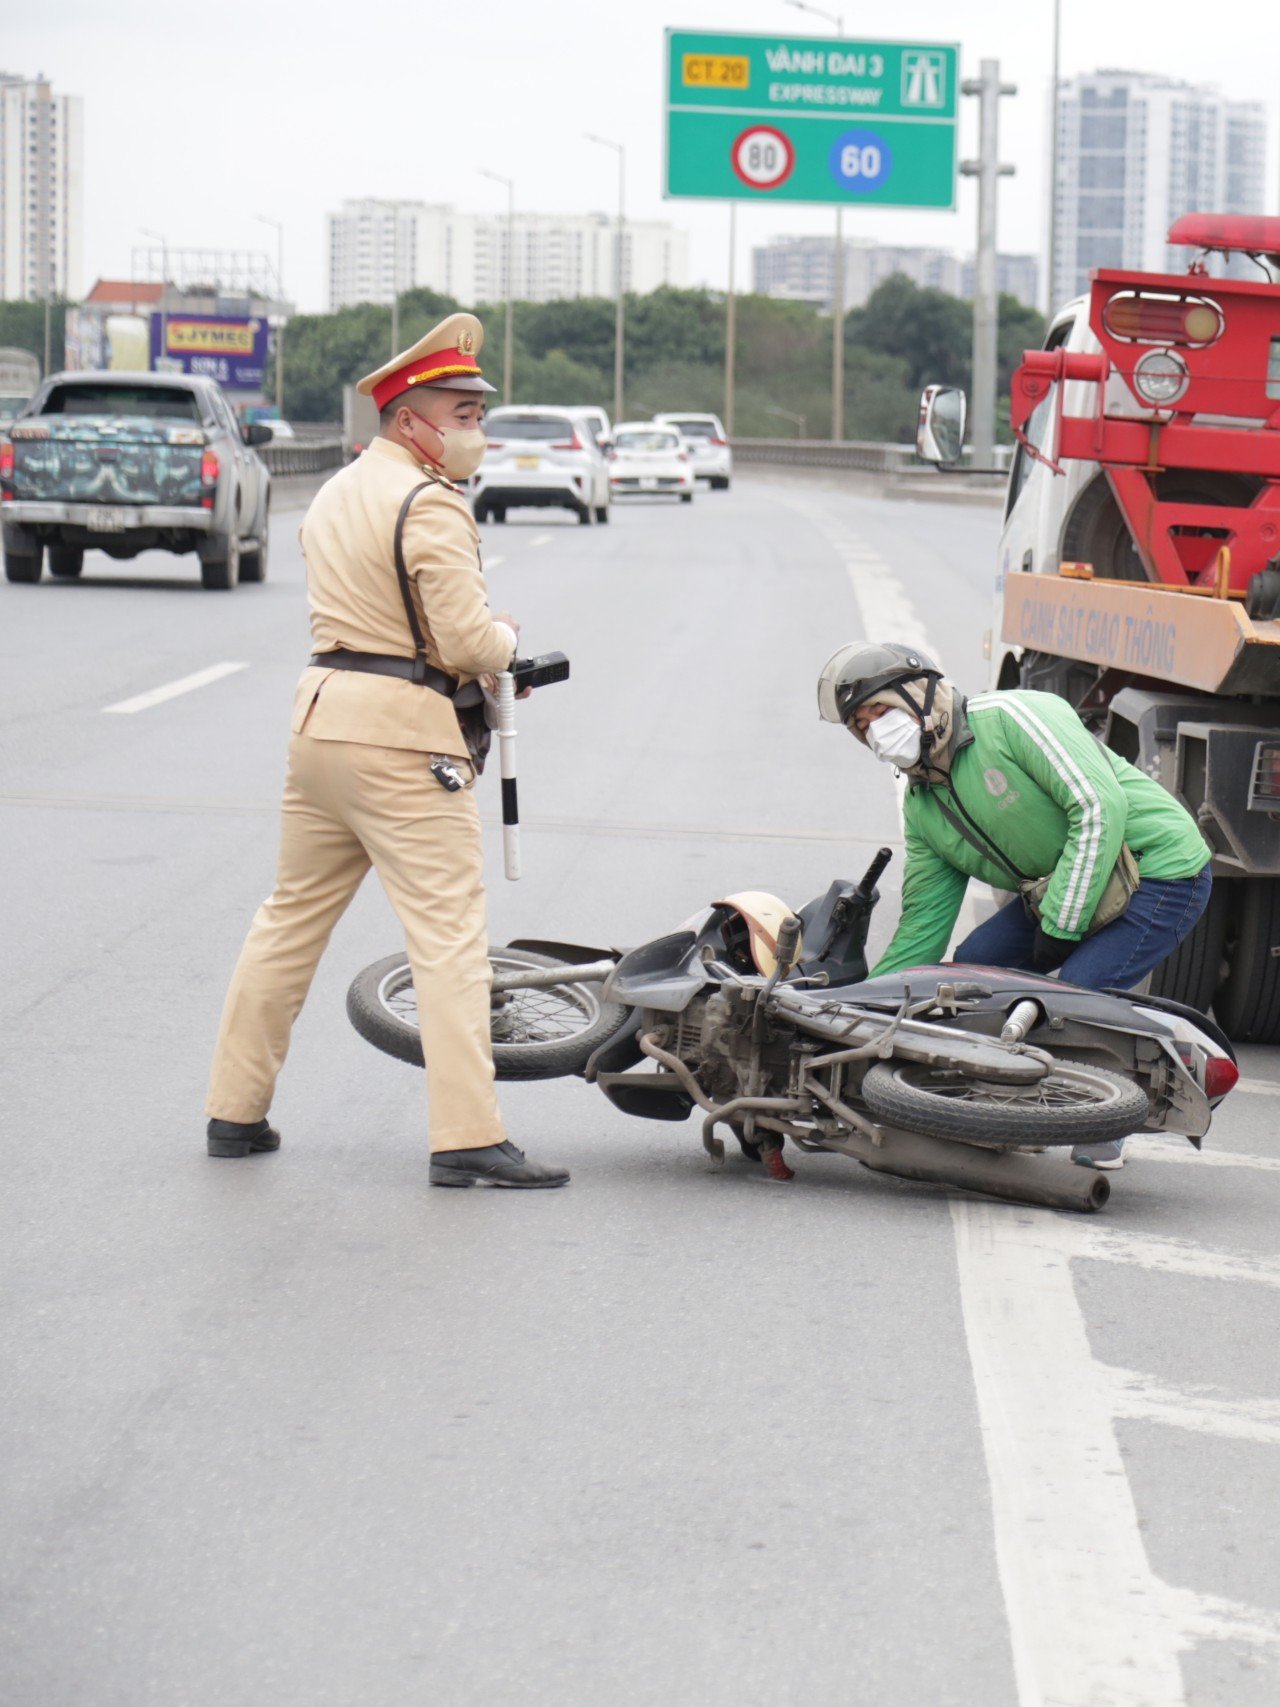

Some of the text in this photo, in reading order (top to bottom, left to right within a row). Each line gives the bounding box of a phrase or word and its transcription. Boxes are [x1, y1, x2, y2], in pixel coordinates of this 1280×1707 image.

[868, 54, 884, 78] 3
[768, 83, 883, 106] EXPRESSWAY
[749, 143, 777, 171] 80
[840, 145, 881, 179] 60
[1086, 609, 1121, 657] GIAO
[1125, 604, 1176, 673] THÔNG
